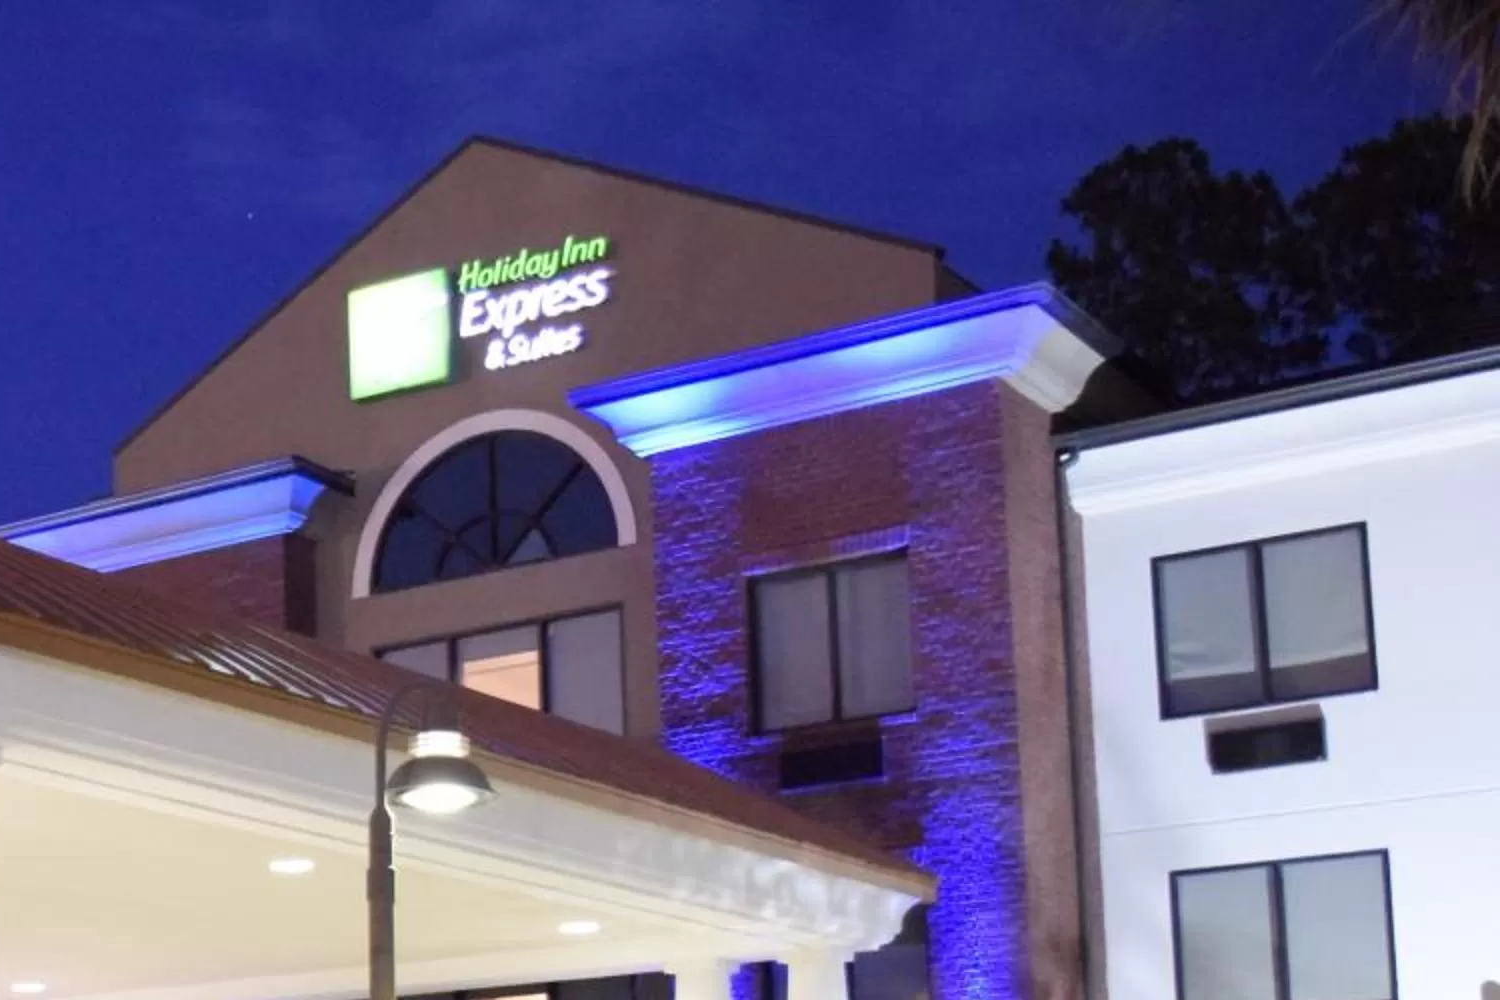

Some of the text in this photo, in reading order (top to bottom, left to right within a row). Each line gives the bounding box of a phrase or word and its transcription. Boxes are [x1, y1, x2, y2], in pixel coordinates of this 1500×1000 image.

[459, 235, 607, 293] Holiday Inn
[459, 268, 612, 339] Express
[484, 325, 584, 371] & Suites
